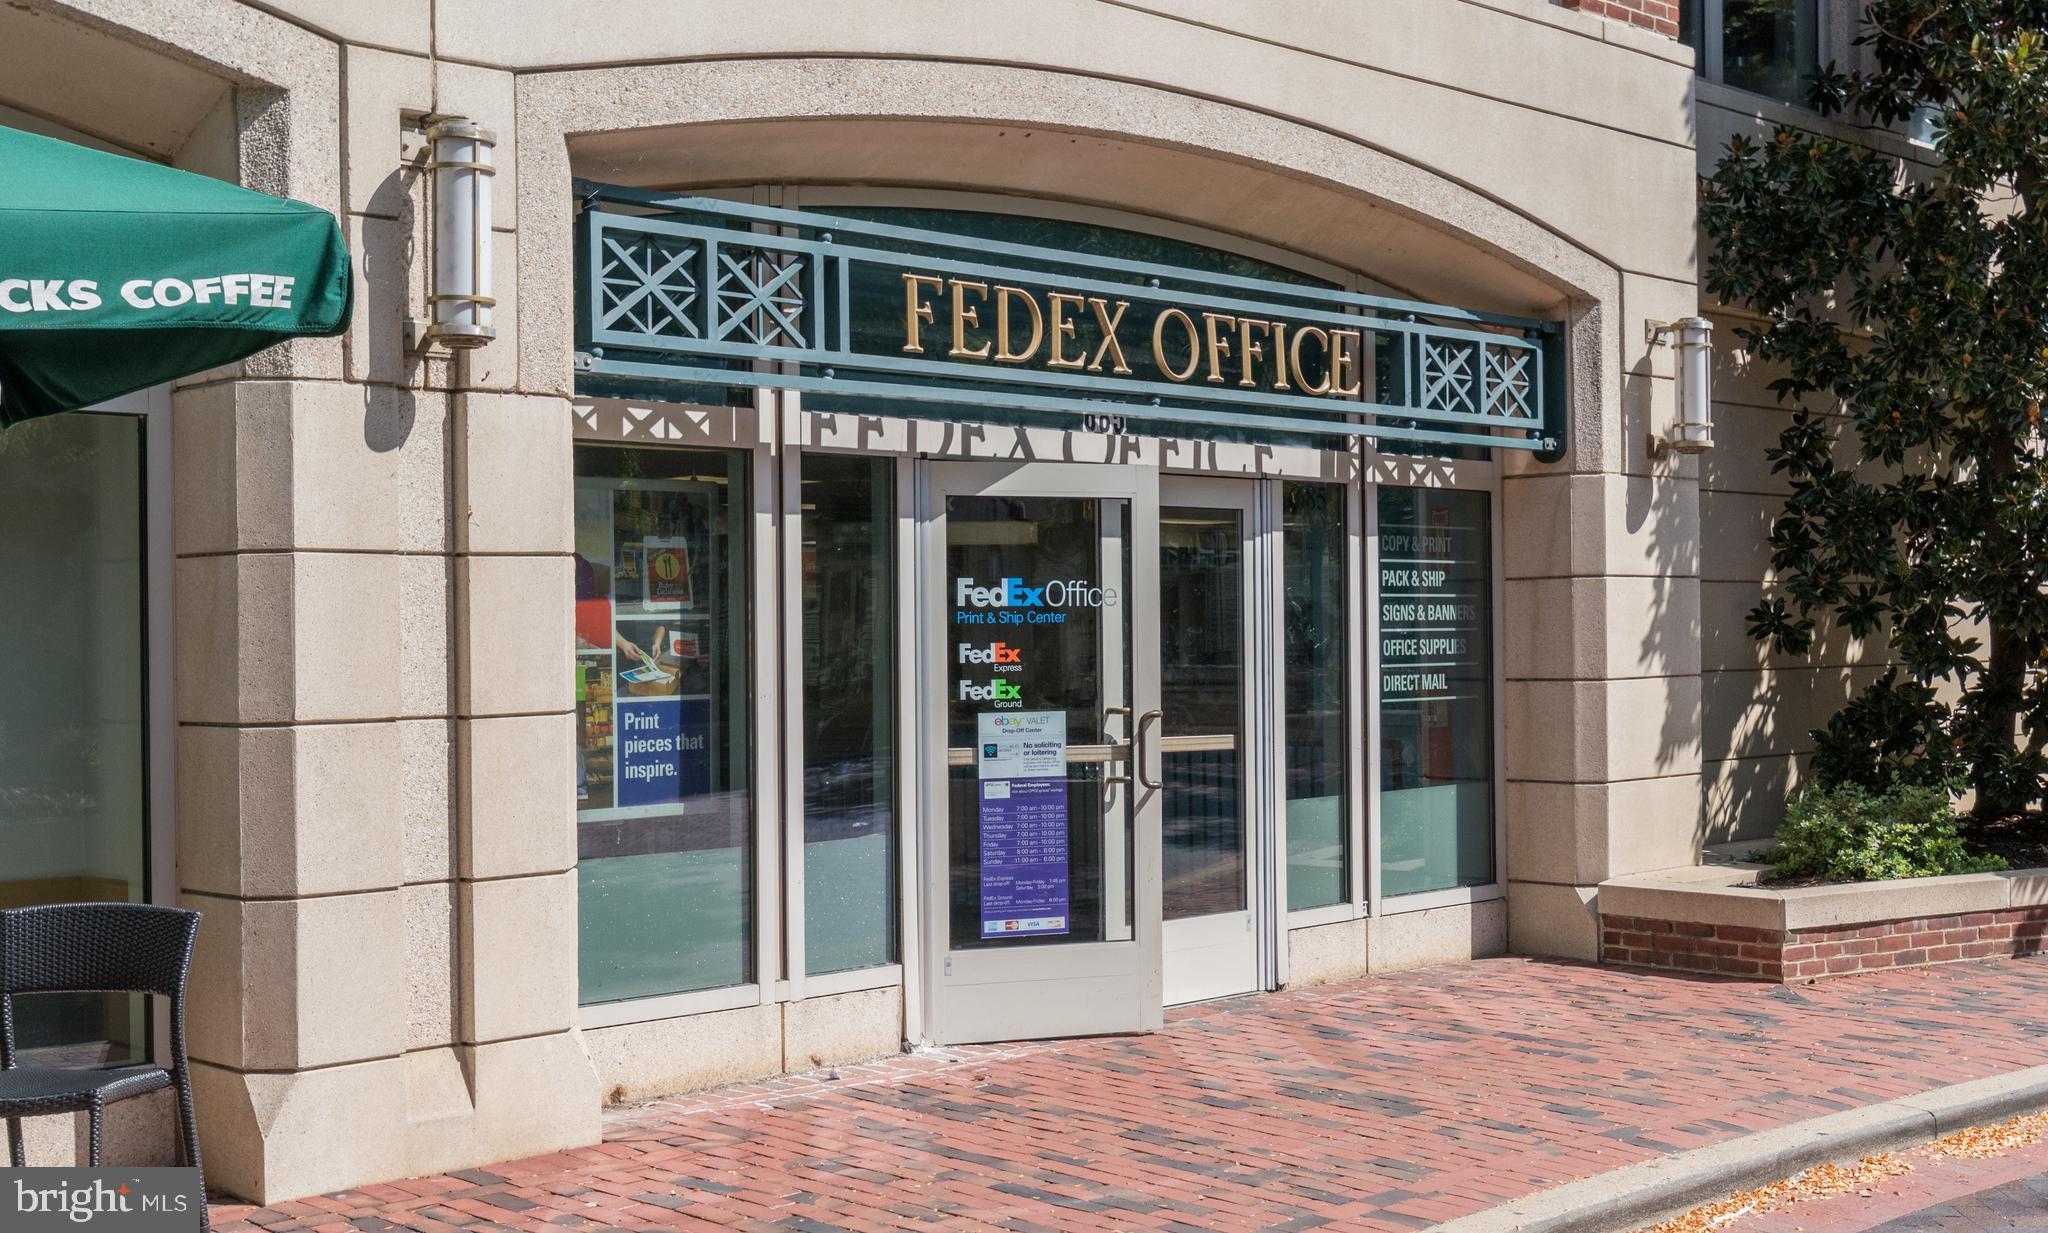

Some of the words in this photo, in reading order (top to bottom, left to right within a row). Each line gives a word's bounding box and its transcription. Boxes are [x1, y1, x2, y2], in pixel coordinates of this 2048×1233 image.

[120, 273, 295, 309] COFFEE
[902, 273, 1132, 375] FEDEX
[1153, 308, 1361, 396] OFFICE
[1382, 535, 1409, 551] COPY
[1412, 536, 1422, 551] &
[1422, 536, 1452, 552] PRINT
[1382, 570, 1409, 587] PACK
[1412, 571, 1420, 587] &
[1422, 571, 1445, 587] SHIP
[958, 578, 1044, 607] FedEx
[1046, 580, 1117, 607] Office
[957, 611, 983, 624] Print
[987, 612, 995, 623] &
[999, 611, 1023, 626] Ship
[1027, 612, 1066, 623] Center
[1383, 604, 1415, 621] SIGNS
[1417, 604, 1425, 620] &
[1428, 604, 1476, 621] BANNERS
[959, 642, 1021, 663] FedEx
[1383, 639, 1417, 656] OFFICE
[1420, 638, 1466, 655] SUPPLIES
[994, 664, 1022, 672] Express
[960, 679, 1021, 700] FedEx
[1384, 674, 1419, 692] DIRECT
[1422, 673, 1448, 690] MAIL
[625, 712, 659, 730] Print
[995, 716, 1022, 726] ebay
[625, 736, 672, 758] pieces
[675, 733, 704, 750] that
[625, 760, 677, 782] inspire.
